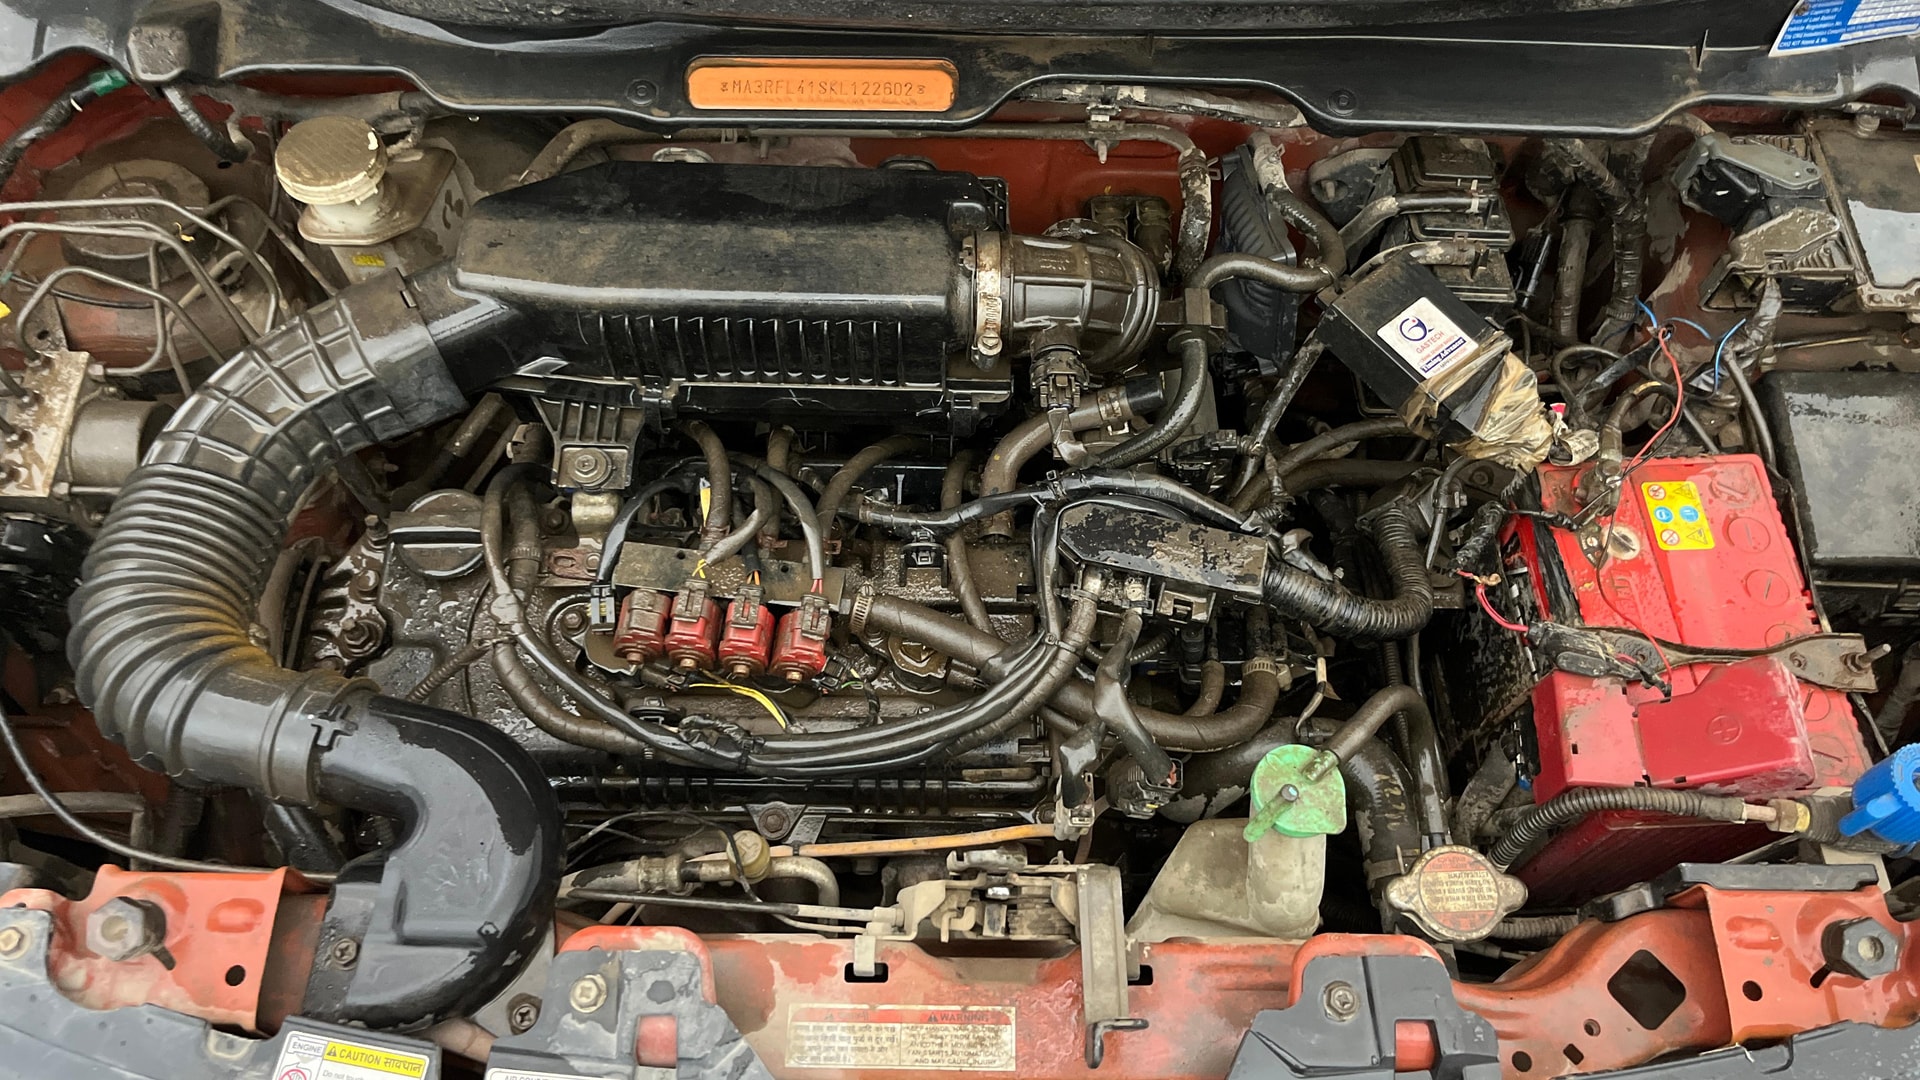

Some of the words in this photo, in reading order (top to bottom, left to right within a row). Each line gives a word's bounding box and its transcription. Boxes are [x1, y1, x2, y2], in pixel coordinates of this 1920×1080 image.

[1416, 331, 1446, 354] GASTECH
[940, 1013, 989, 1022] WARNING
[292, 1042, 323, 1053] ENGINE
[339, 1050, 381, 1065] CAUTION
